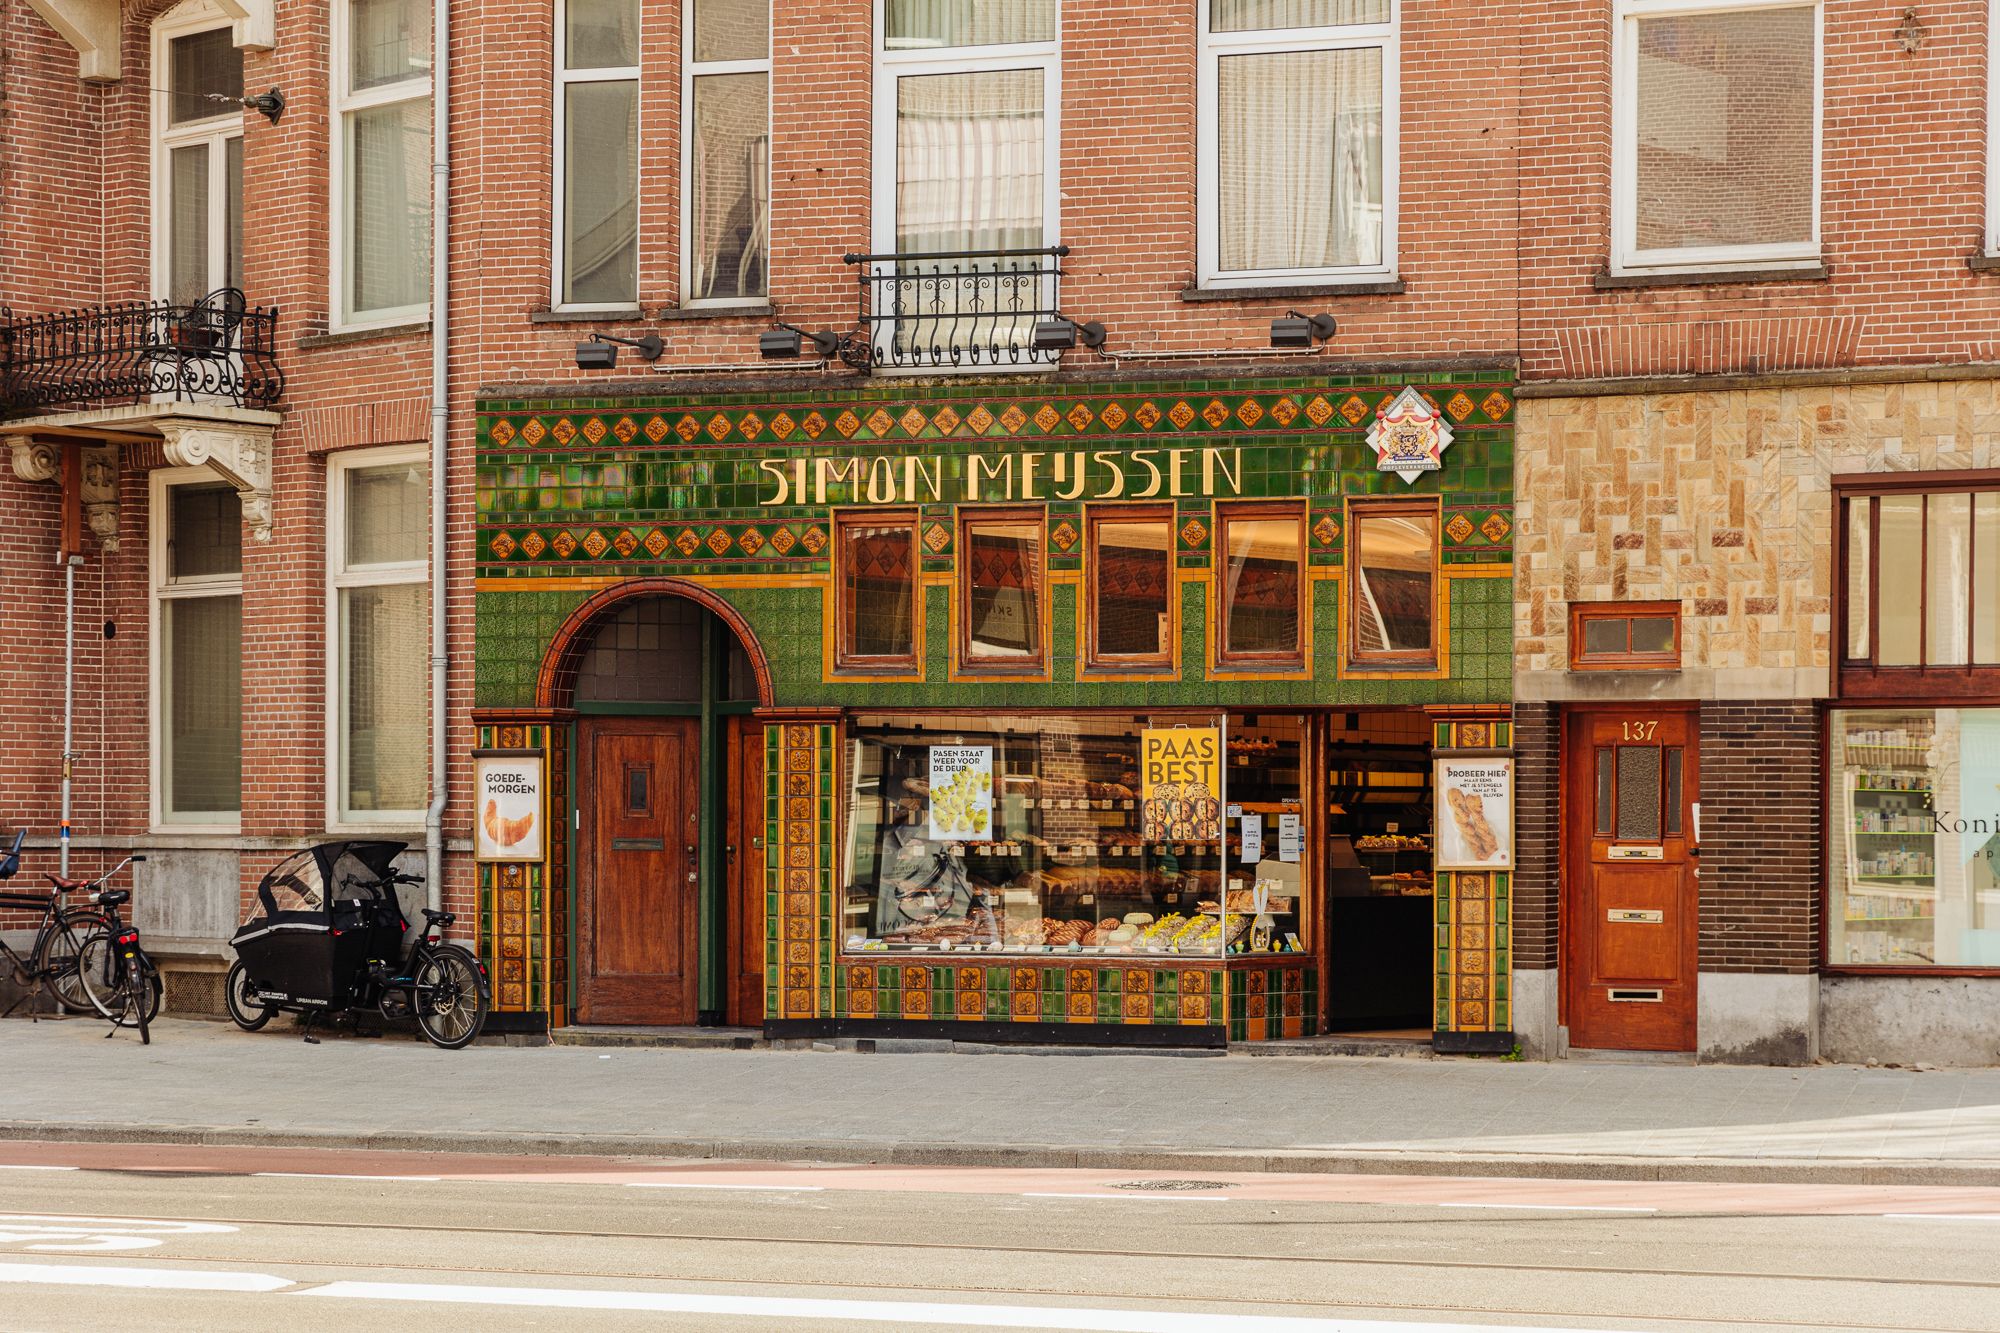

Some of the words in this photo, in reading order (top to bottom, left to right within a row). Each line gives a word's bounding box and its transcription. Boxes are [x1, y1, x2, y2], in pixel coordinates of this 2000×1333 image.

[760, 456, 941, 505] SIMON
[1622, 721, 1659, 741] 137
[1148, 737, 1214, 760] PAAS
[485, 773, 526, 783] GOEDE-
[1148, 760, 1214, 785] BEST
[488, 784, 536, 794] MORGEN
[1933, 811, 2000, 833] Koni
